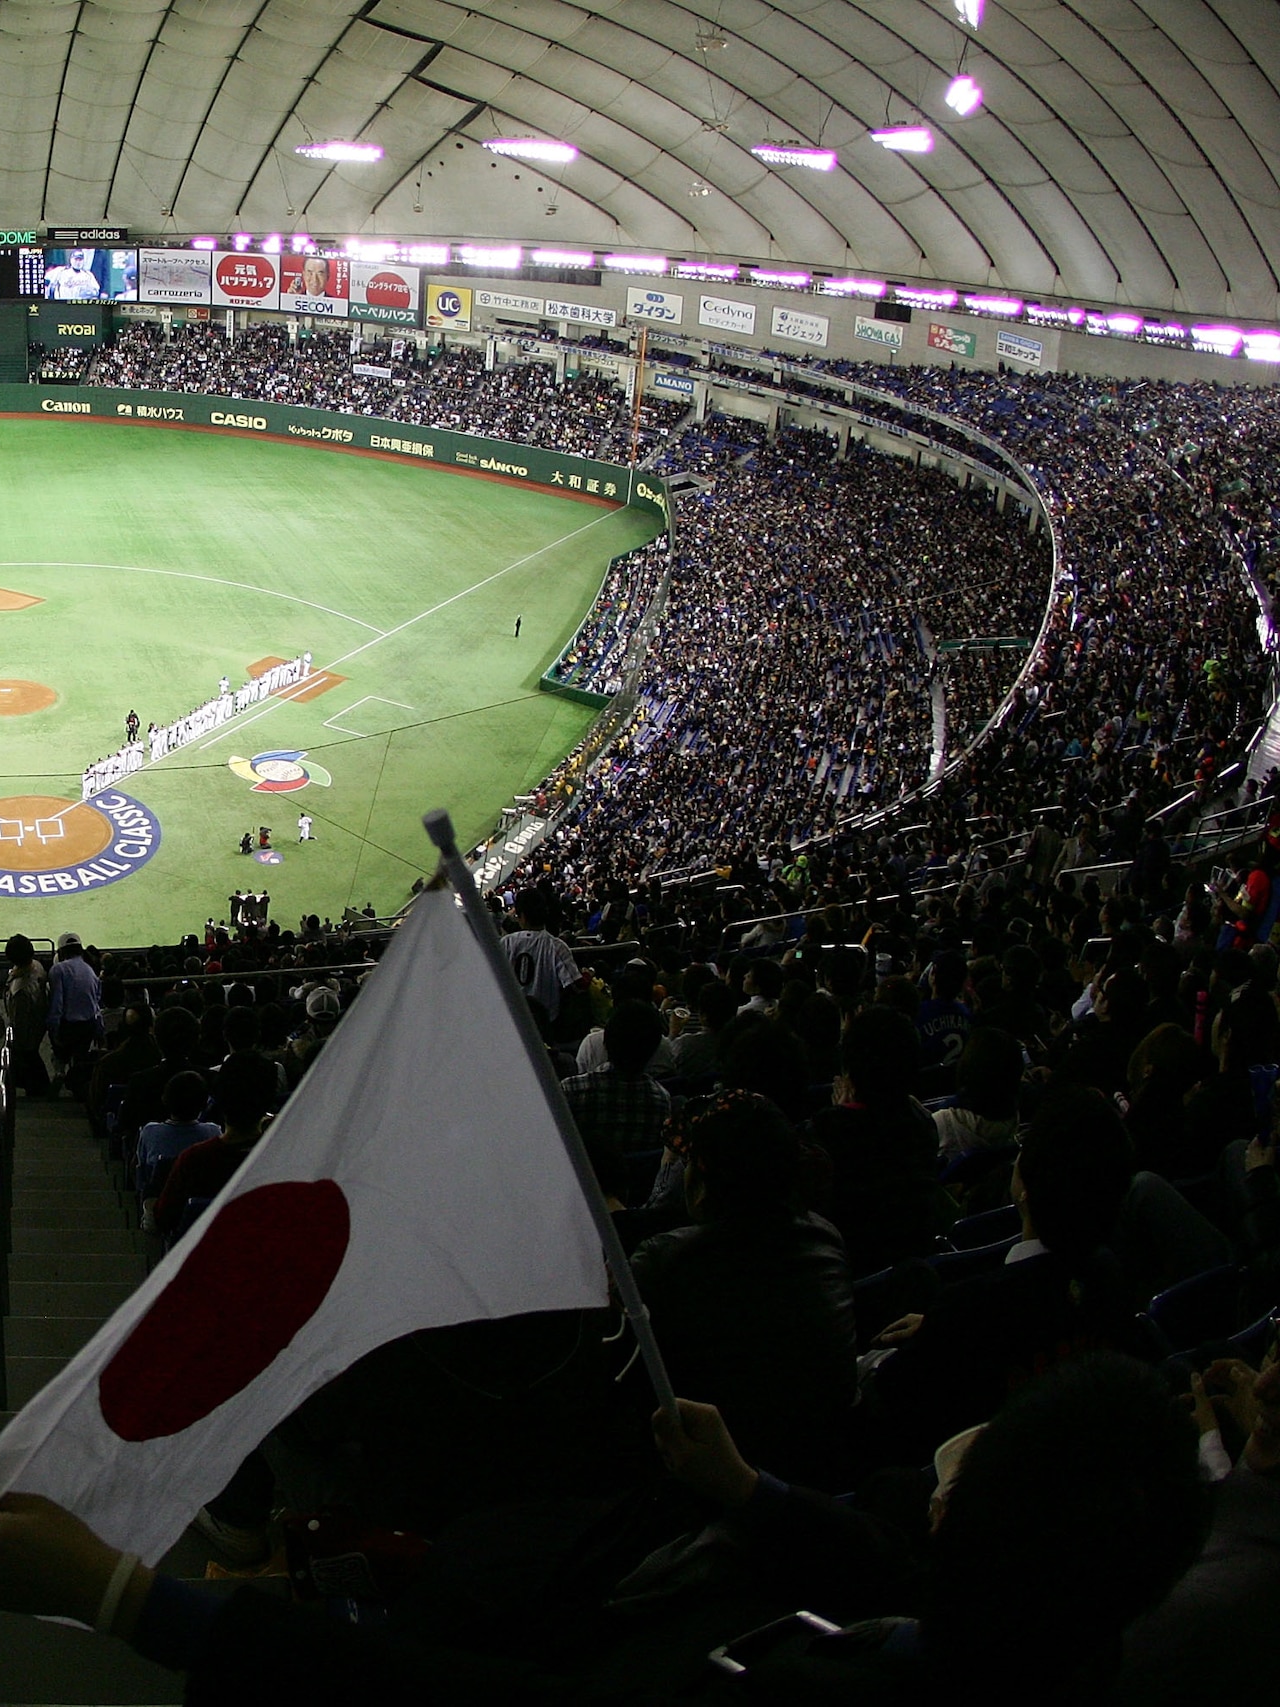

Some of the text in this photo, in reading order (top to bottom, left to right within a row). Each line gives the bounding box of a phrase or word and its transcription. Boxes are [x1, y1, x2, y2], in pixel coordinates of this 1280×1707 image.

[80, 229, 121, 239] adidas
[234, 263, 257, 276] 元気
[147, 289, 203, 298] carrozzeria
[229, 298, 263, 306] オロナミンC
[294, 301, 334, 314] SECOM
[437, 296, 461, 313] UC
[493, 296, 540, 311] 竹中工務店
[703, 300, 754, 320] Cedyna
[351, 305, 416, 323] ヘーベルハウス
[548, 303, 615, 325] 松本歯科大学
[633, 302, 676, 320] ダイダン
[57, 324, 96, 337] RYOBI
[776, 323, 824, 343] エイジェック
[884, 330, 900, 345] GAS
[655, 376, 692, 391] AMANO
[41, 399, 91, 414] Canon
[136, 405, 185, 421] 積水ハウス
[210, 411, 267, 430] CASIO
[321, 426, 354, 442] クボタ
[370, 435, 434, 458] 日本興亜損保
[480, 457, 528, 477] SANKYO
[550, 470, 617, 498] 大和証券
[96, 795, 153, 858] CLASSIC
[515, 953, 535, 985] 0
